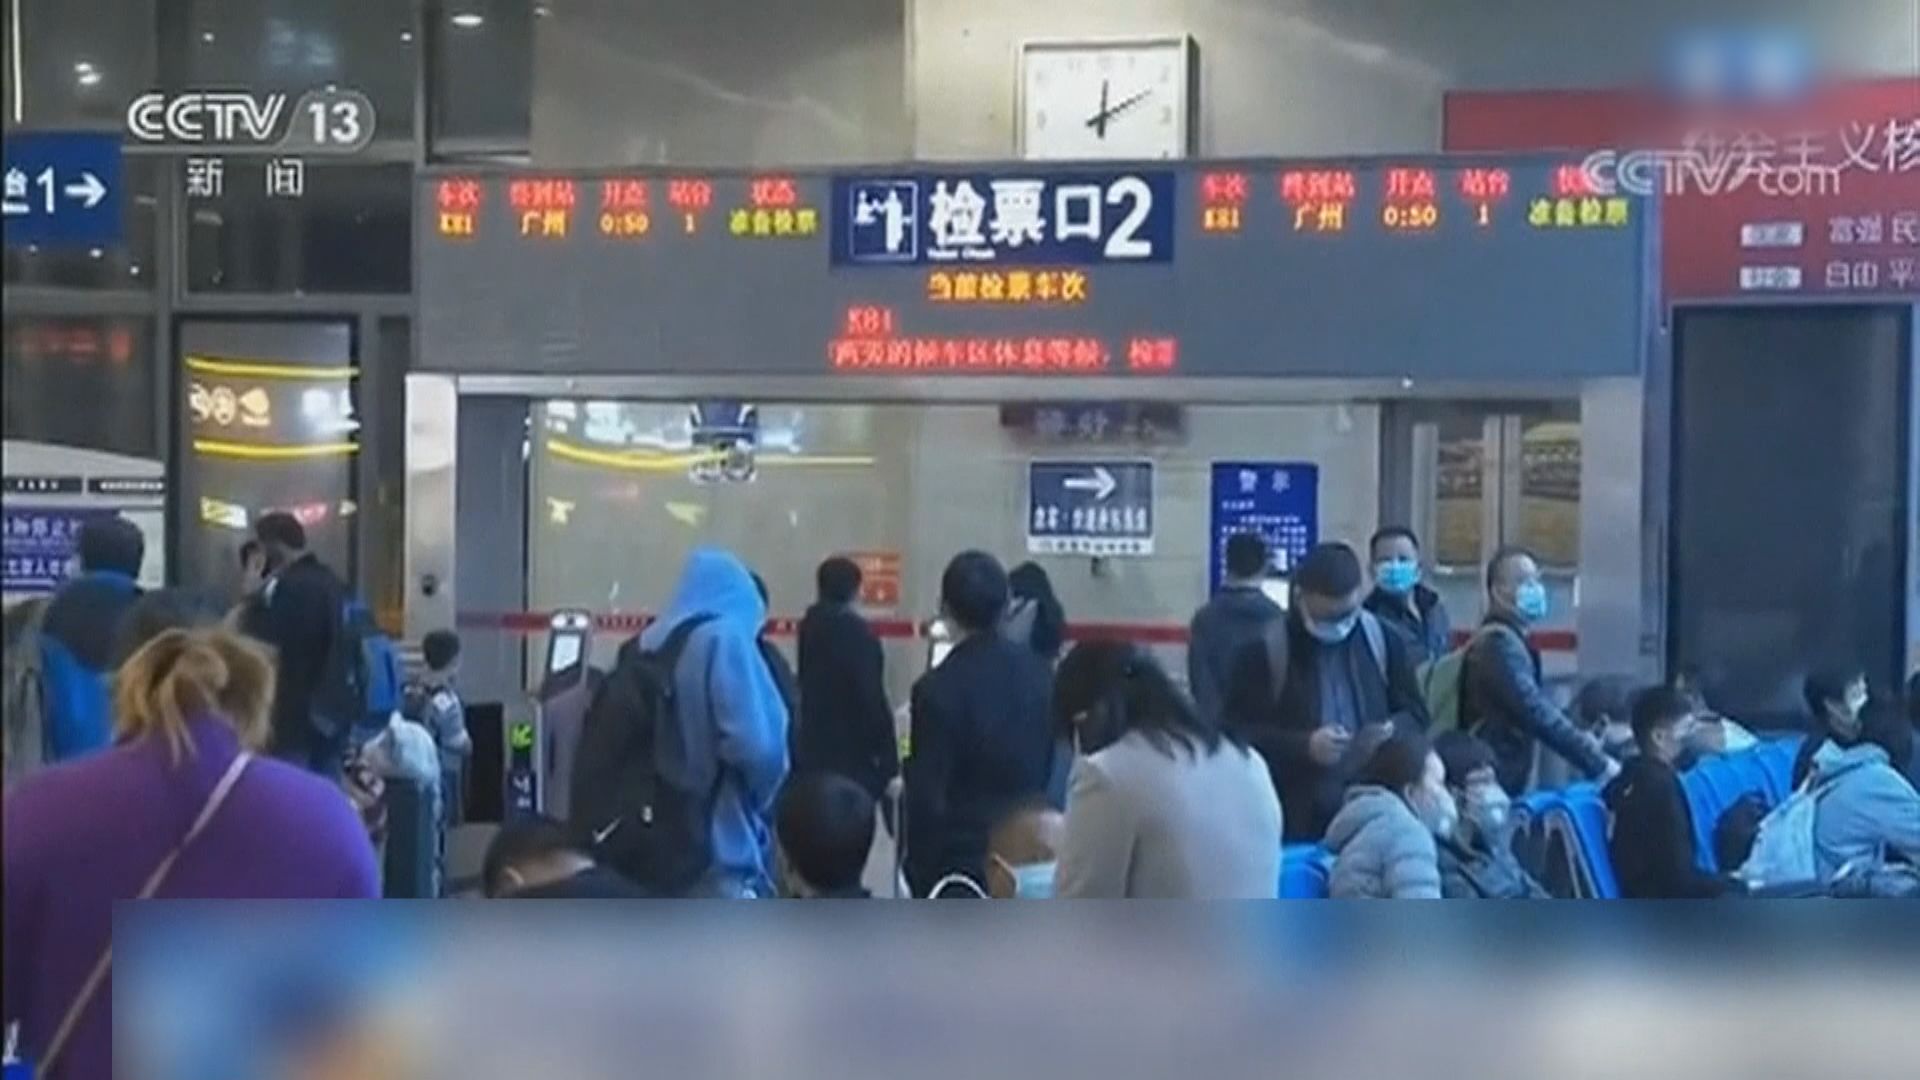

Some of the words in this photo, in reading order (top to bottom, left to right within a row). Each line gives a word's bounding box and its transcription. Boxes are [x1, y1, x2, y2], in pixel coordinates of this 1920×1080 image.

[520, 209, 566, 236] 广州
[600, 213, 648, 234] 0:50
[684, 213, 695, 233] 1
[1294, 203, 1343, 231] 广州
[1383, 205, 1438, 226] 0:50
[1479, 202, 1489, 226] 1
[929, 271, 1086, 300] 当前检票车次
[848, 308, 892, 334] K81
